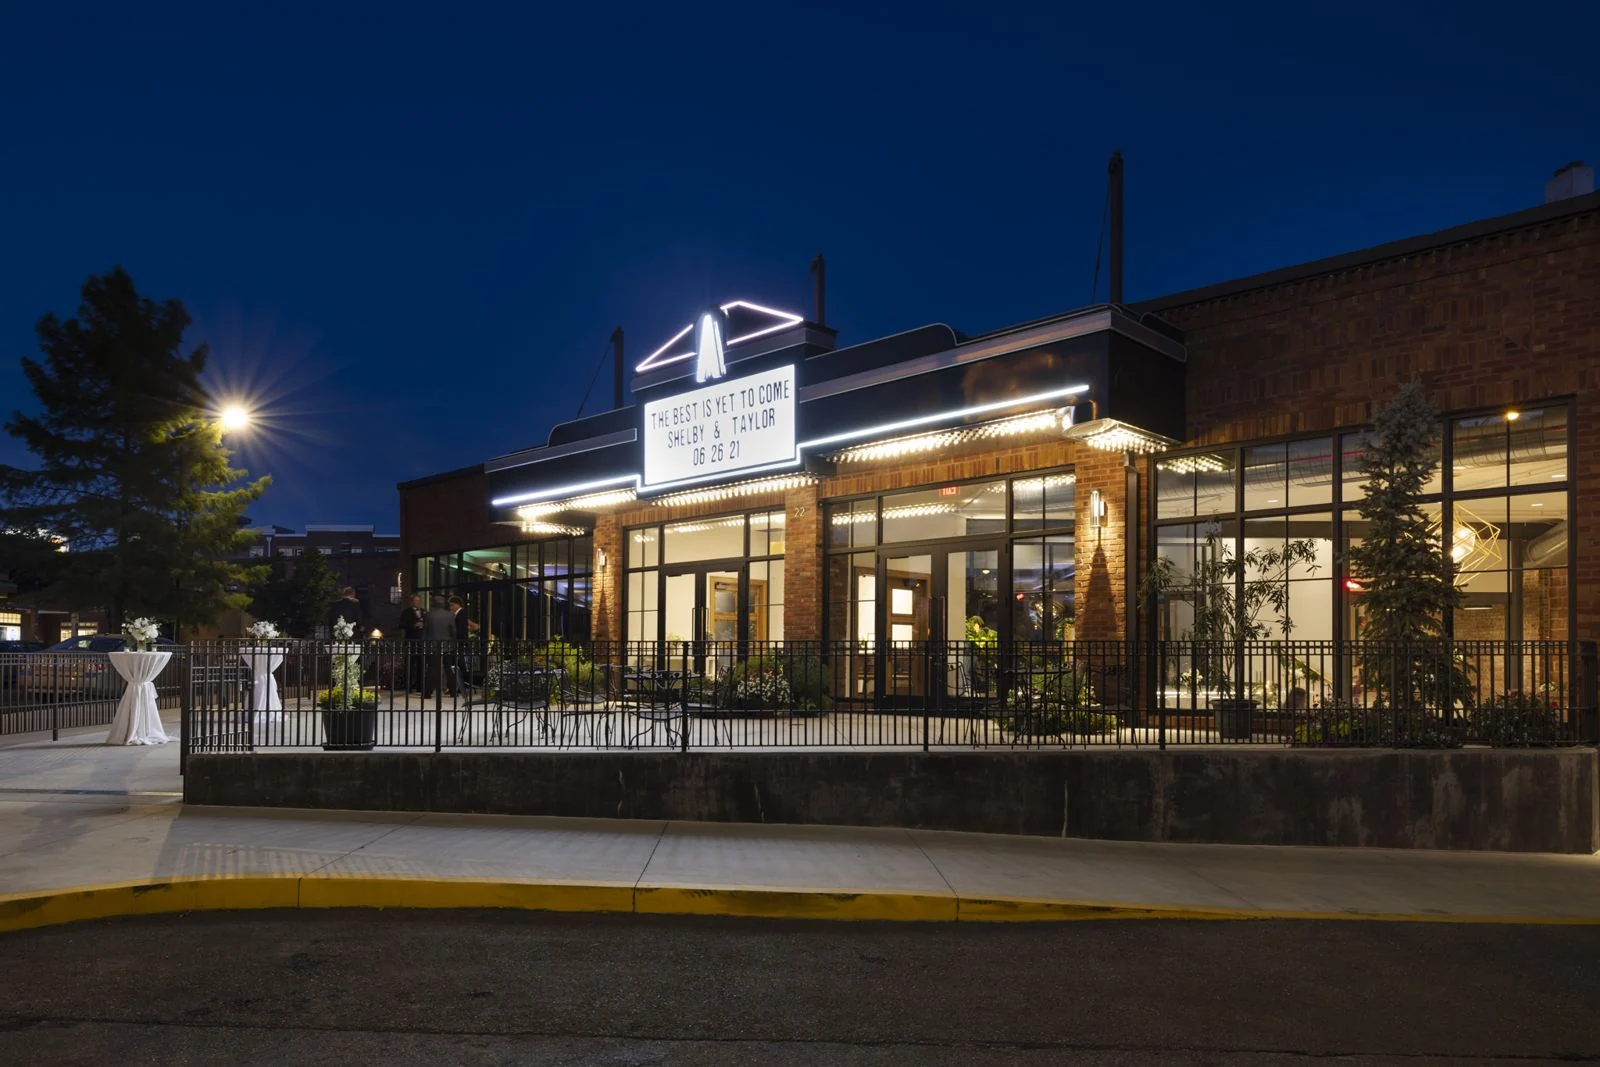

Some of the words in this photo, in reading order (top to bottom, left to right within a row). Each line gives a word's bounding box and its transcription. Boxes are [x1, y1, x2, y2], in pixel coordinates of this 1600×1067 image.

[651, 410, 669, 430] THE
[673, 402, 698, 425] BEST
[702, 398, 712, 417] IS
[715, 393, 735, 415] YET
[740, 388, 755, 409] TO
[759, 380, 789, 405] COME
[668, 425, 705, 449] SHELBY
[713, 420, 721, 439] &
[732, 408, 775, 435] TAYLOR
[693, 447, 705, 466] 06
[711, 443, 723, 463] 26
[729, 440, 740, 459] 21
[794, 506, 805, 518] 22
